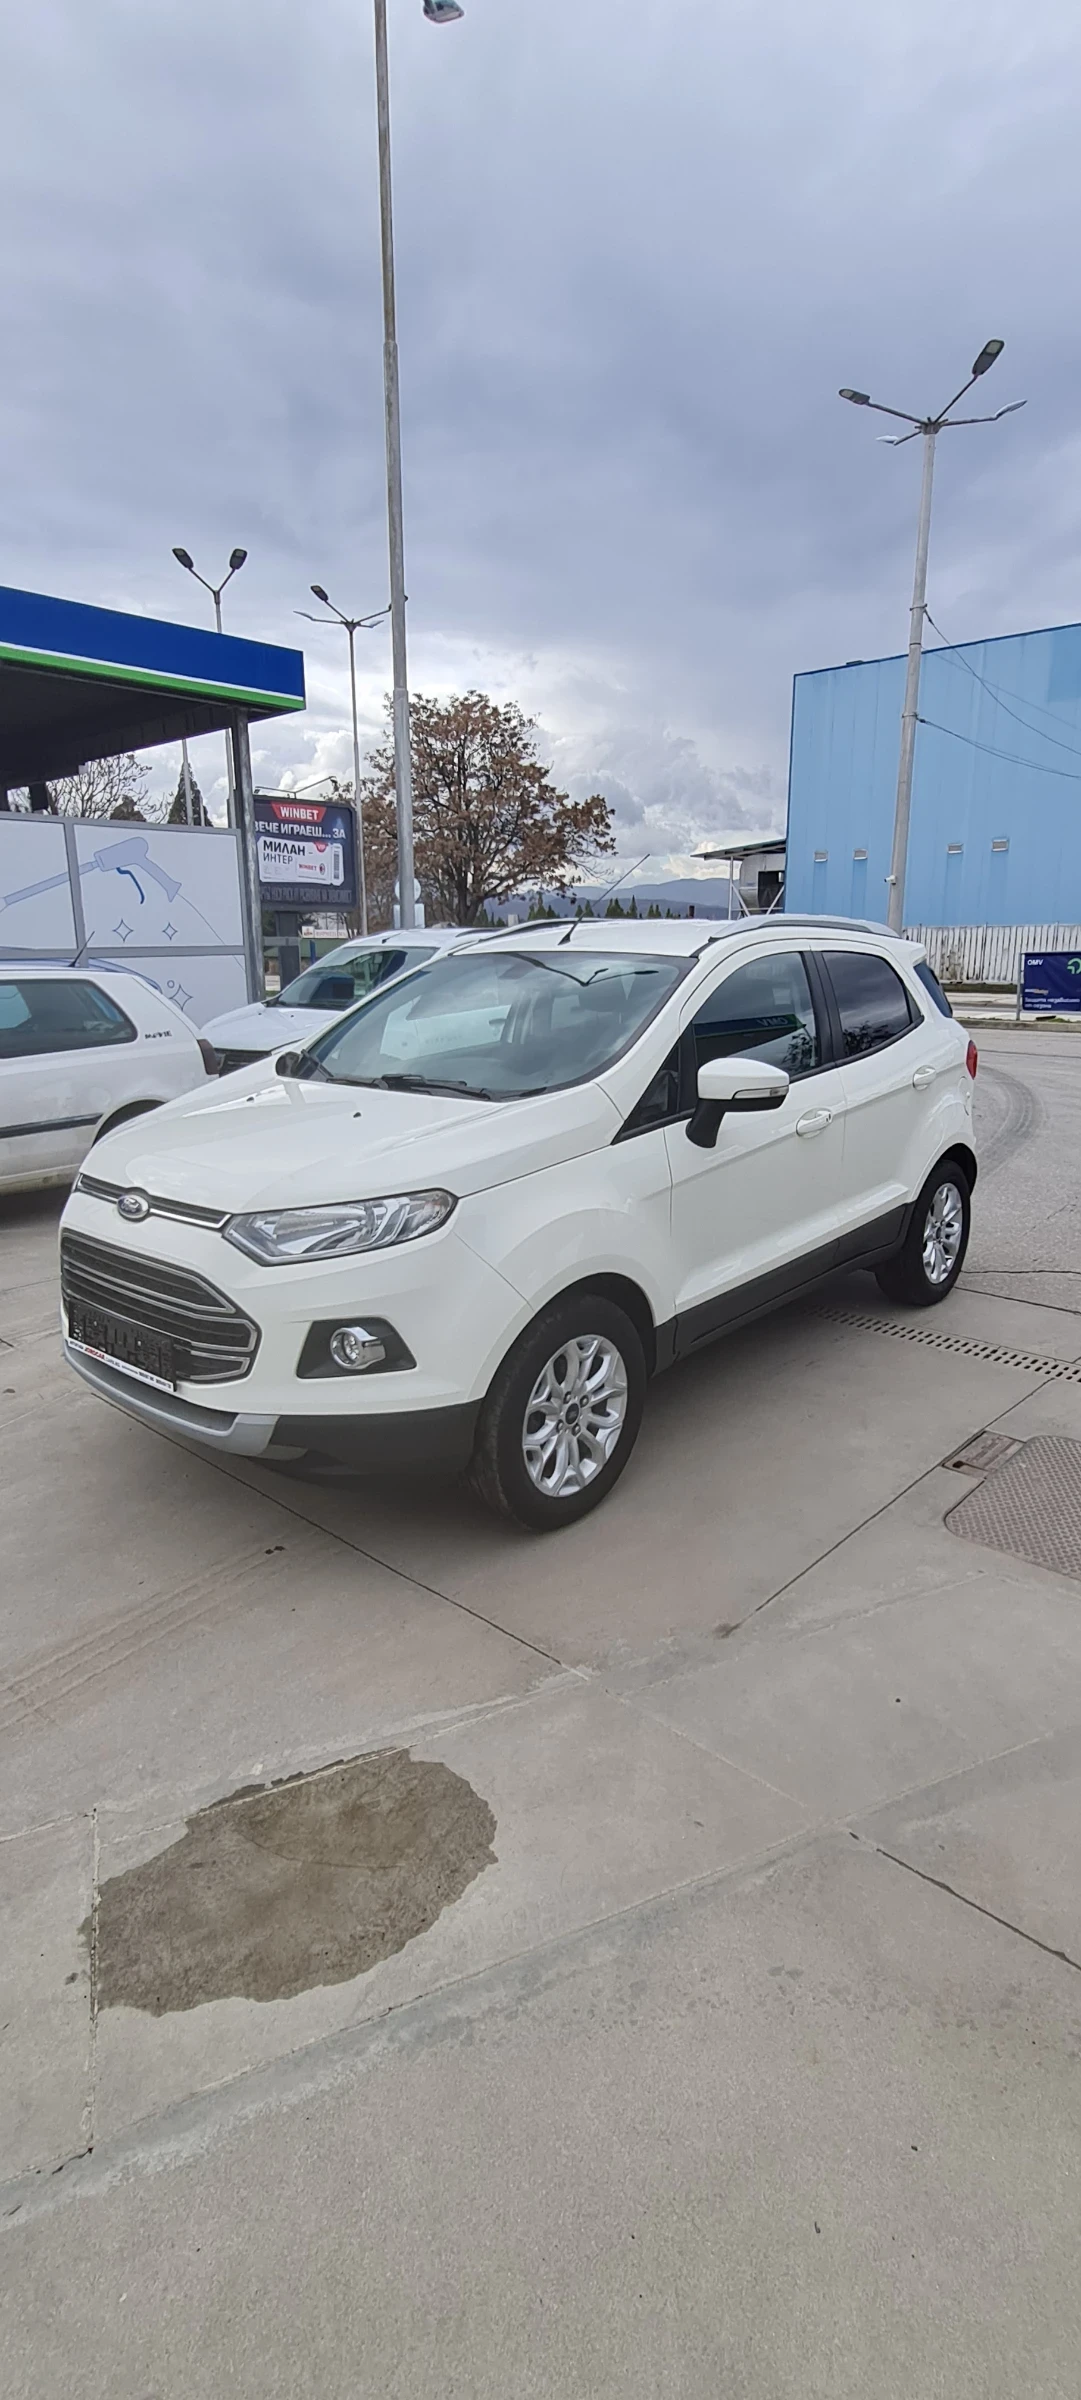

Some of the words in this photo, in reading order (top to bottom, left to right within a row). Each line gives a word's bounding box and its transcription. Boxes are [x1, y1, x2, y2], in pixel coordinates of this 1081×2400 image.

[280, 806, 319, 821] WINBET
[280, 824, 331, 838] ИГРАЕШ...
[333, 828, 346, 840] ЗА
[263, 840, 306, 856] МИЛАН
[263, 853, 293, 864] ИНТЕР
